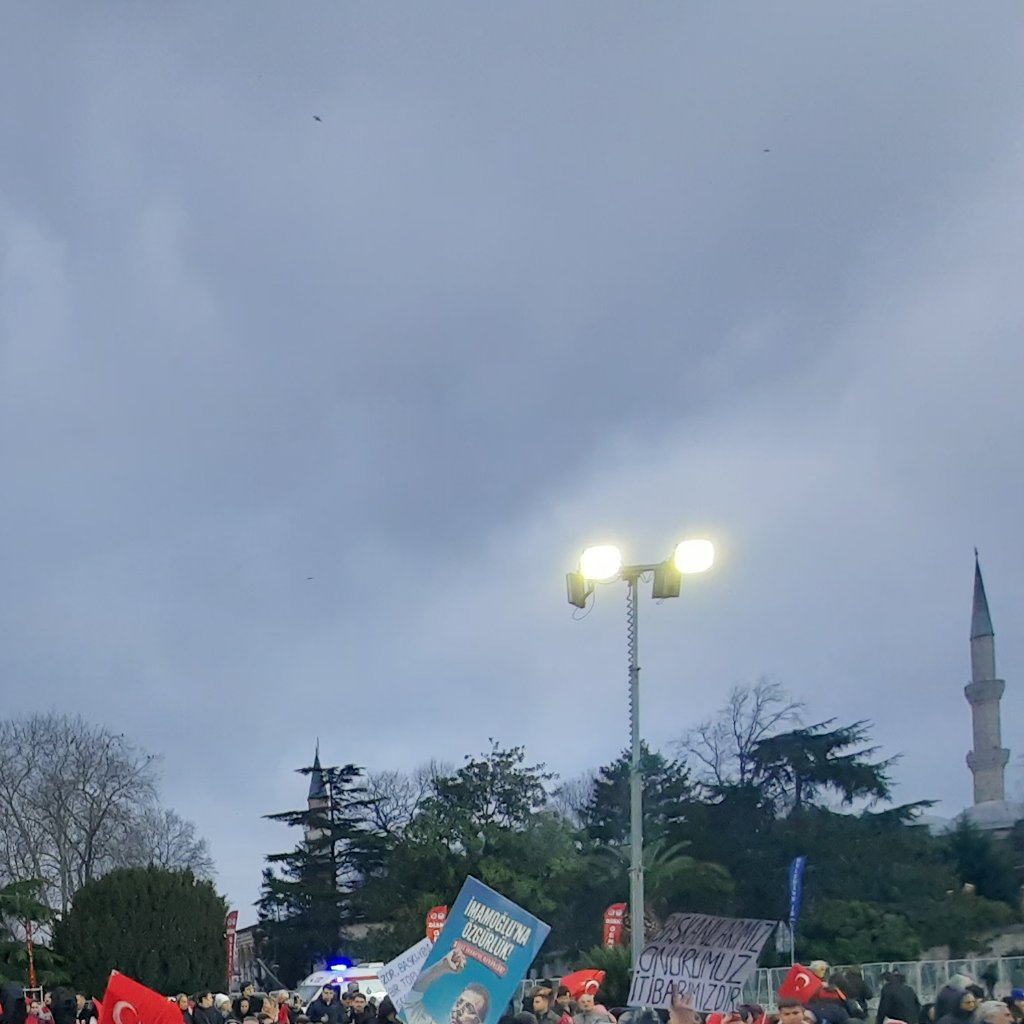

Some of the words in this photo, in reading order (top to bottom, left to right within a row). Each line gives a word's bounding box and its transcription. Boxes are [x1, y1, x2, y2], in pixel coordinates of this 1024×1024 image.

[461, 919, 515, 962] ÖZGÜRLÜK!
[463, 896, 532, 946] İMAMOĞLU'NA
[639, 945, 752, 985] ONURUMUZ
